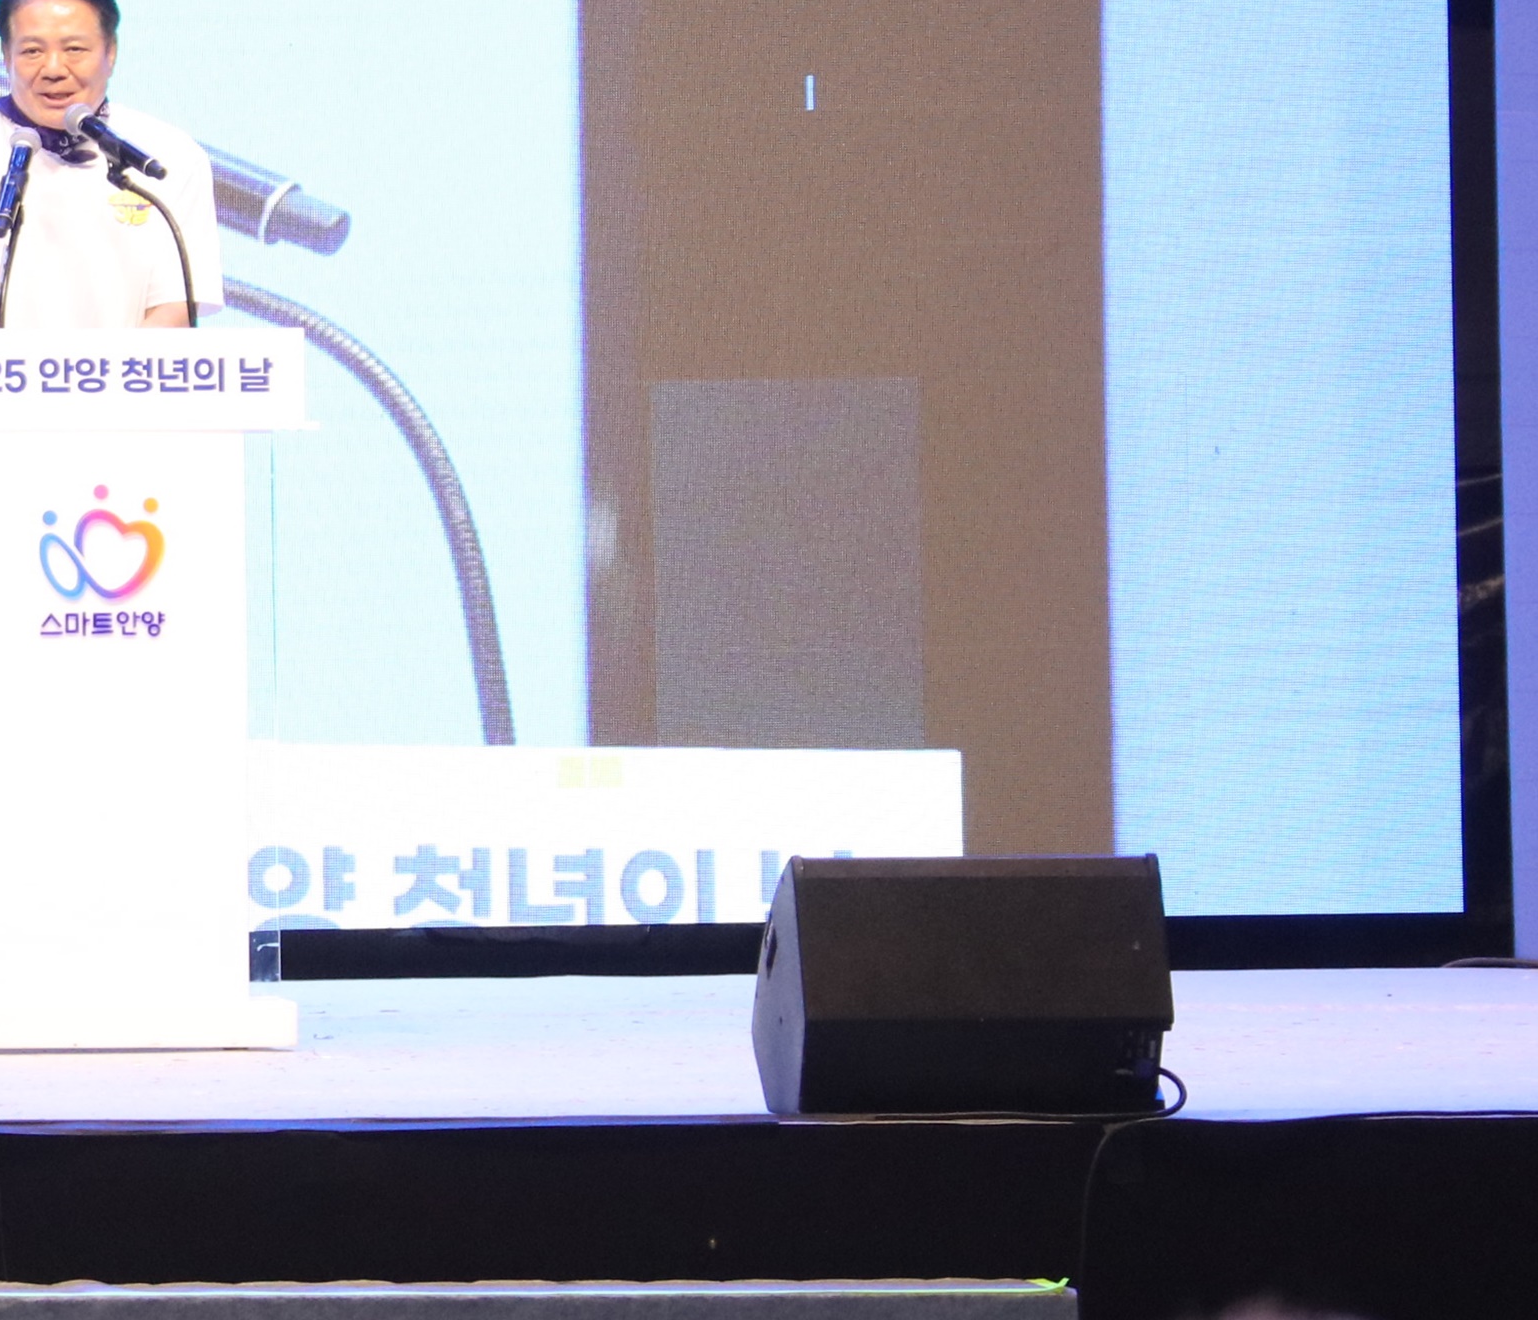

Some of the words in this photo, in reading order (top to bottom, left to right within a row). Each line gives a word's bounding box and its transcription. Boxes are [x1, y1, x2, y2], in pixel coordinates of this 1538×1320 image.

[39, 357, 111, 393] 안양
[122, 357, 226, 393] 청년의
[239, 357, 273, 393] 날
[40, 611, 166, 637] 스마트안양
